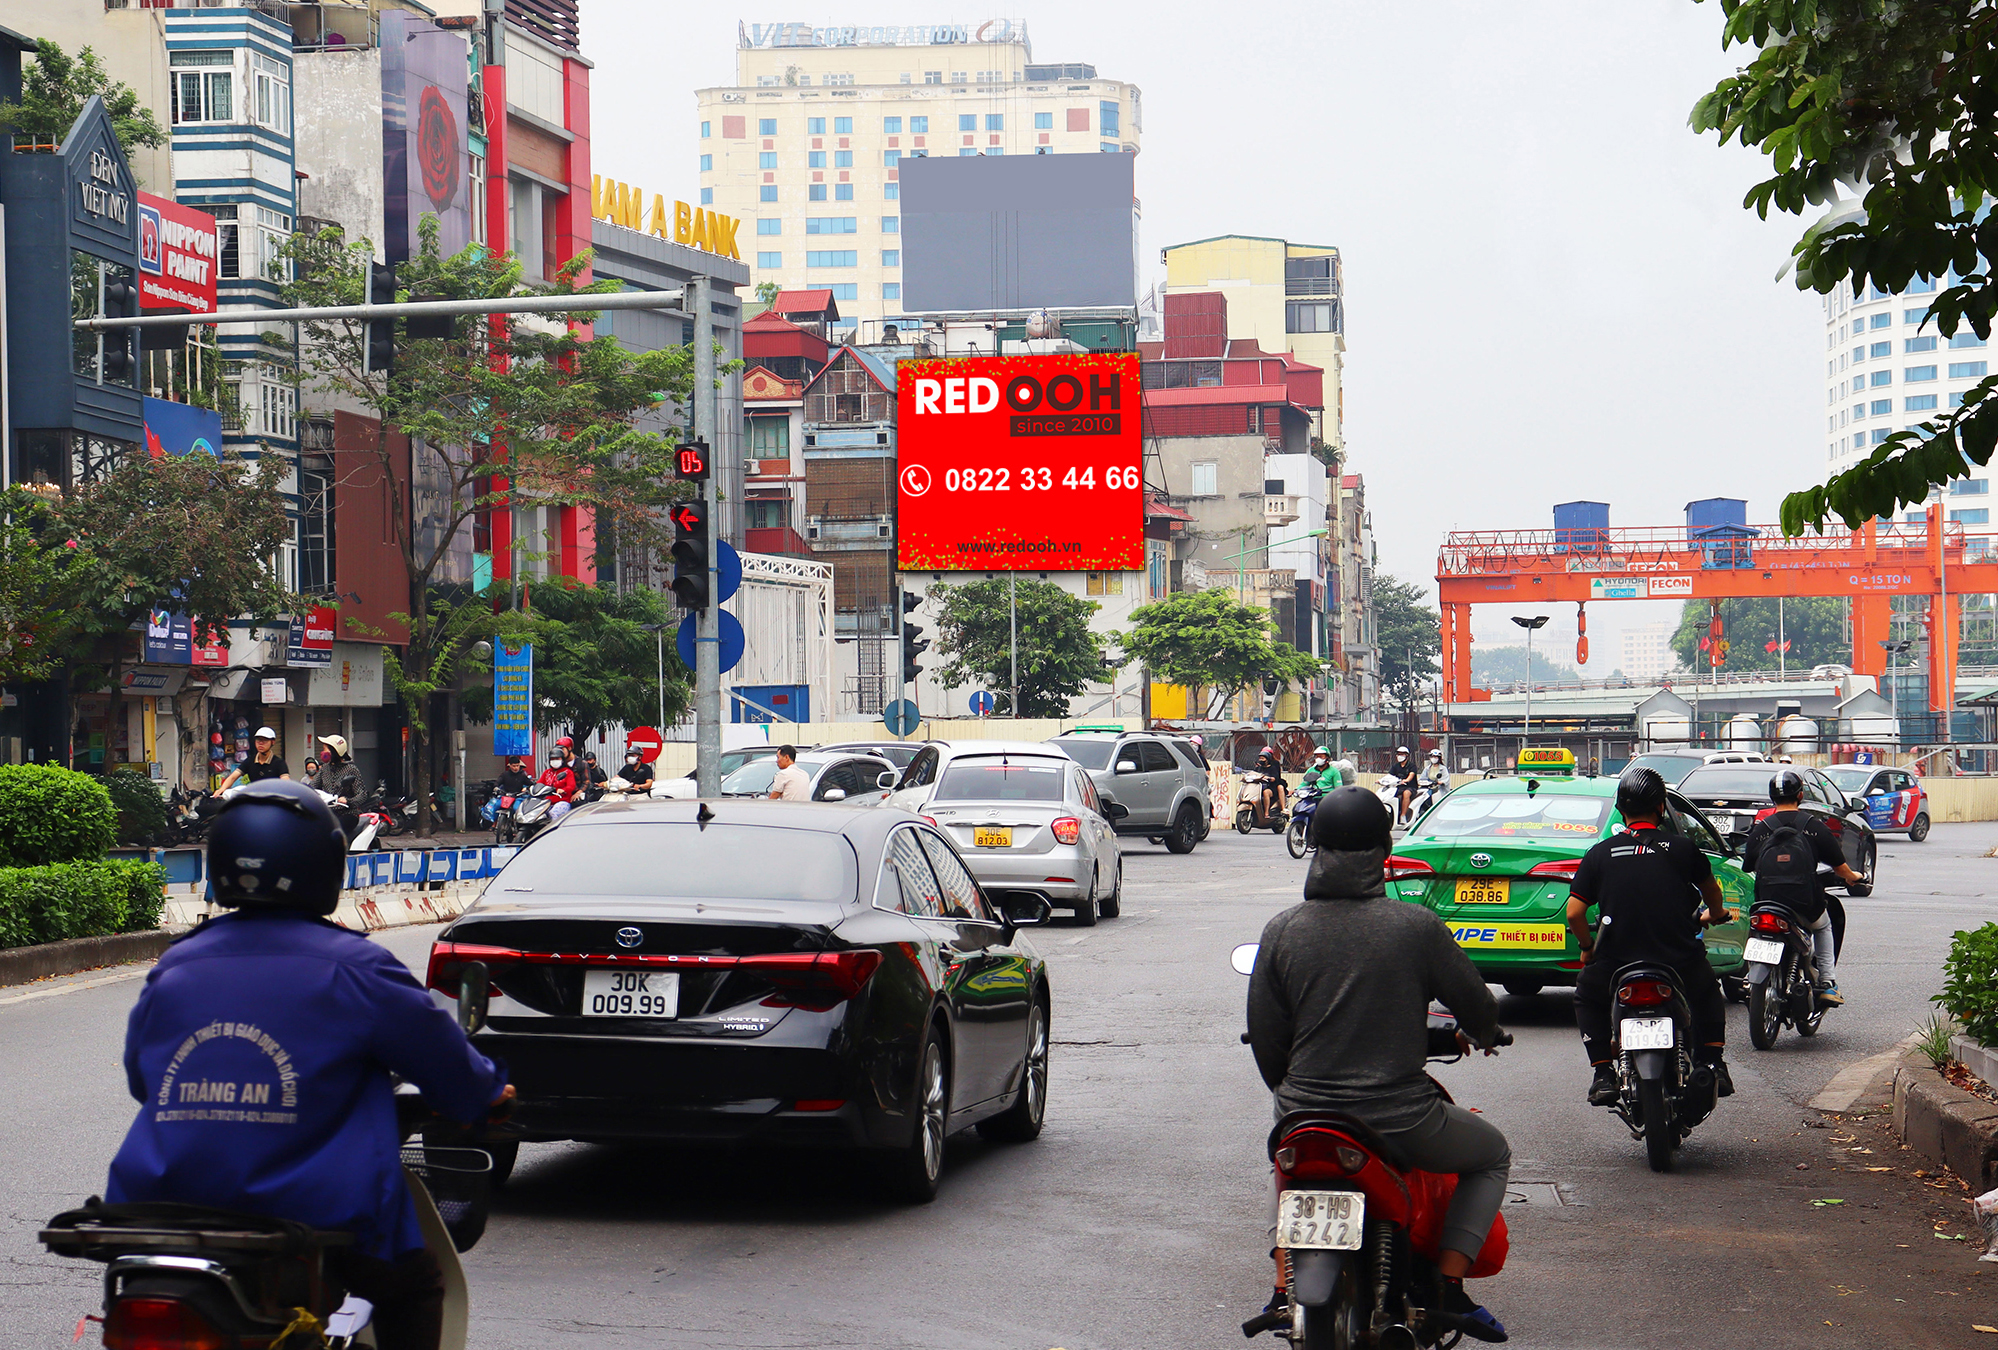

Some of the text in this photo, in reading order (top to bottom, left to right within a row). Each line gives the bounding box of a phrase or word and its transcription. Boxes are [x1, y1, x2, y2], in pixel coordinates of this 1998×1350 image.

[751, 22, 968, 46] VIT CORPORATION
[80, 181, 128, 225] VIỆT MỸ
[591, 174, 740, 260] NAM A BANK
[161, 218, 215, 258] NIPPON
[168, 251, 209, 286] PAINT
[915, 374, 1120, 414] RED OOH
[1017, 417, 1113, 432] since 2010
[681, 451, 703, 473] 05
[946, 466, 1139, 491] 0822 33 44 66
[957, 539, 1081, 552] www.redooh.vn
[1652, 579, 1690, 588] FECON
[1850, 576, 1858, 585] Q
[1871, 576, 1882, 584] 15
[1533, 751, 1563, 761] 1055
[985, 828, 1001, 836] 30E
[1553, 823, 1598, 834] 1055
[978, 837, 1007, 845] 812.03
[1472, 878, 1494, 890] 29E
[1460, 891, 1502, 902] 038.86
[1501, 929, 1526, 942] THIẾT
[1529, 932, 1539, 943] BỊ
[1541, 931, 1562, 943] ĐIỆN
[550, 953, 708, 962] AVALON
[611, 973, 649, 992] 30K
[593, 995, 665, 1014] 009.99
[1626, 1034, 1669, 1047] 019.43
[179, 1078, 270, 1104] TRÀNG AN
[1292, 1196, 1352, 1220] 38-H9
[1290, 1220, 1348, 1246] 6242
